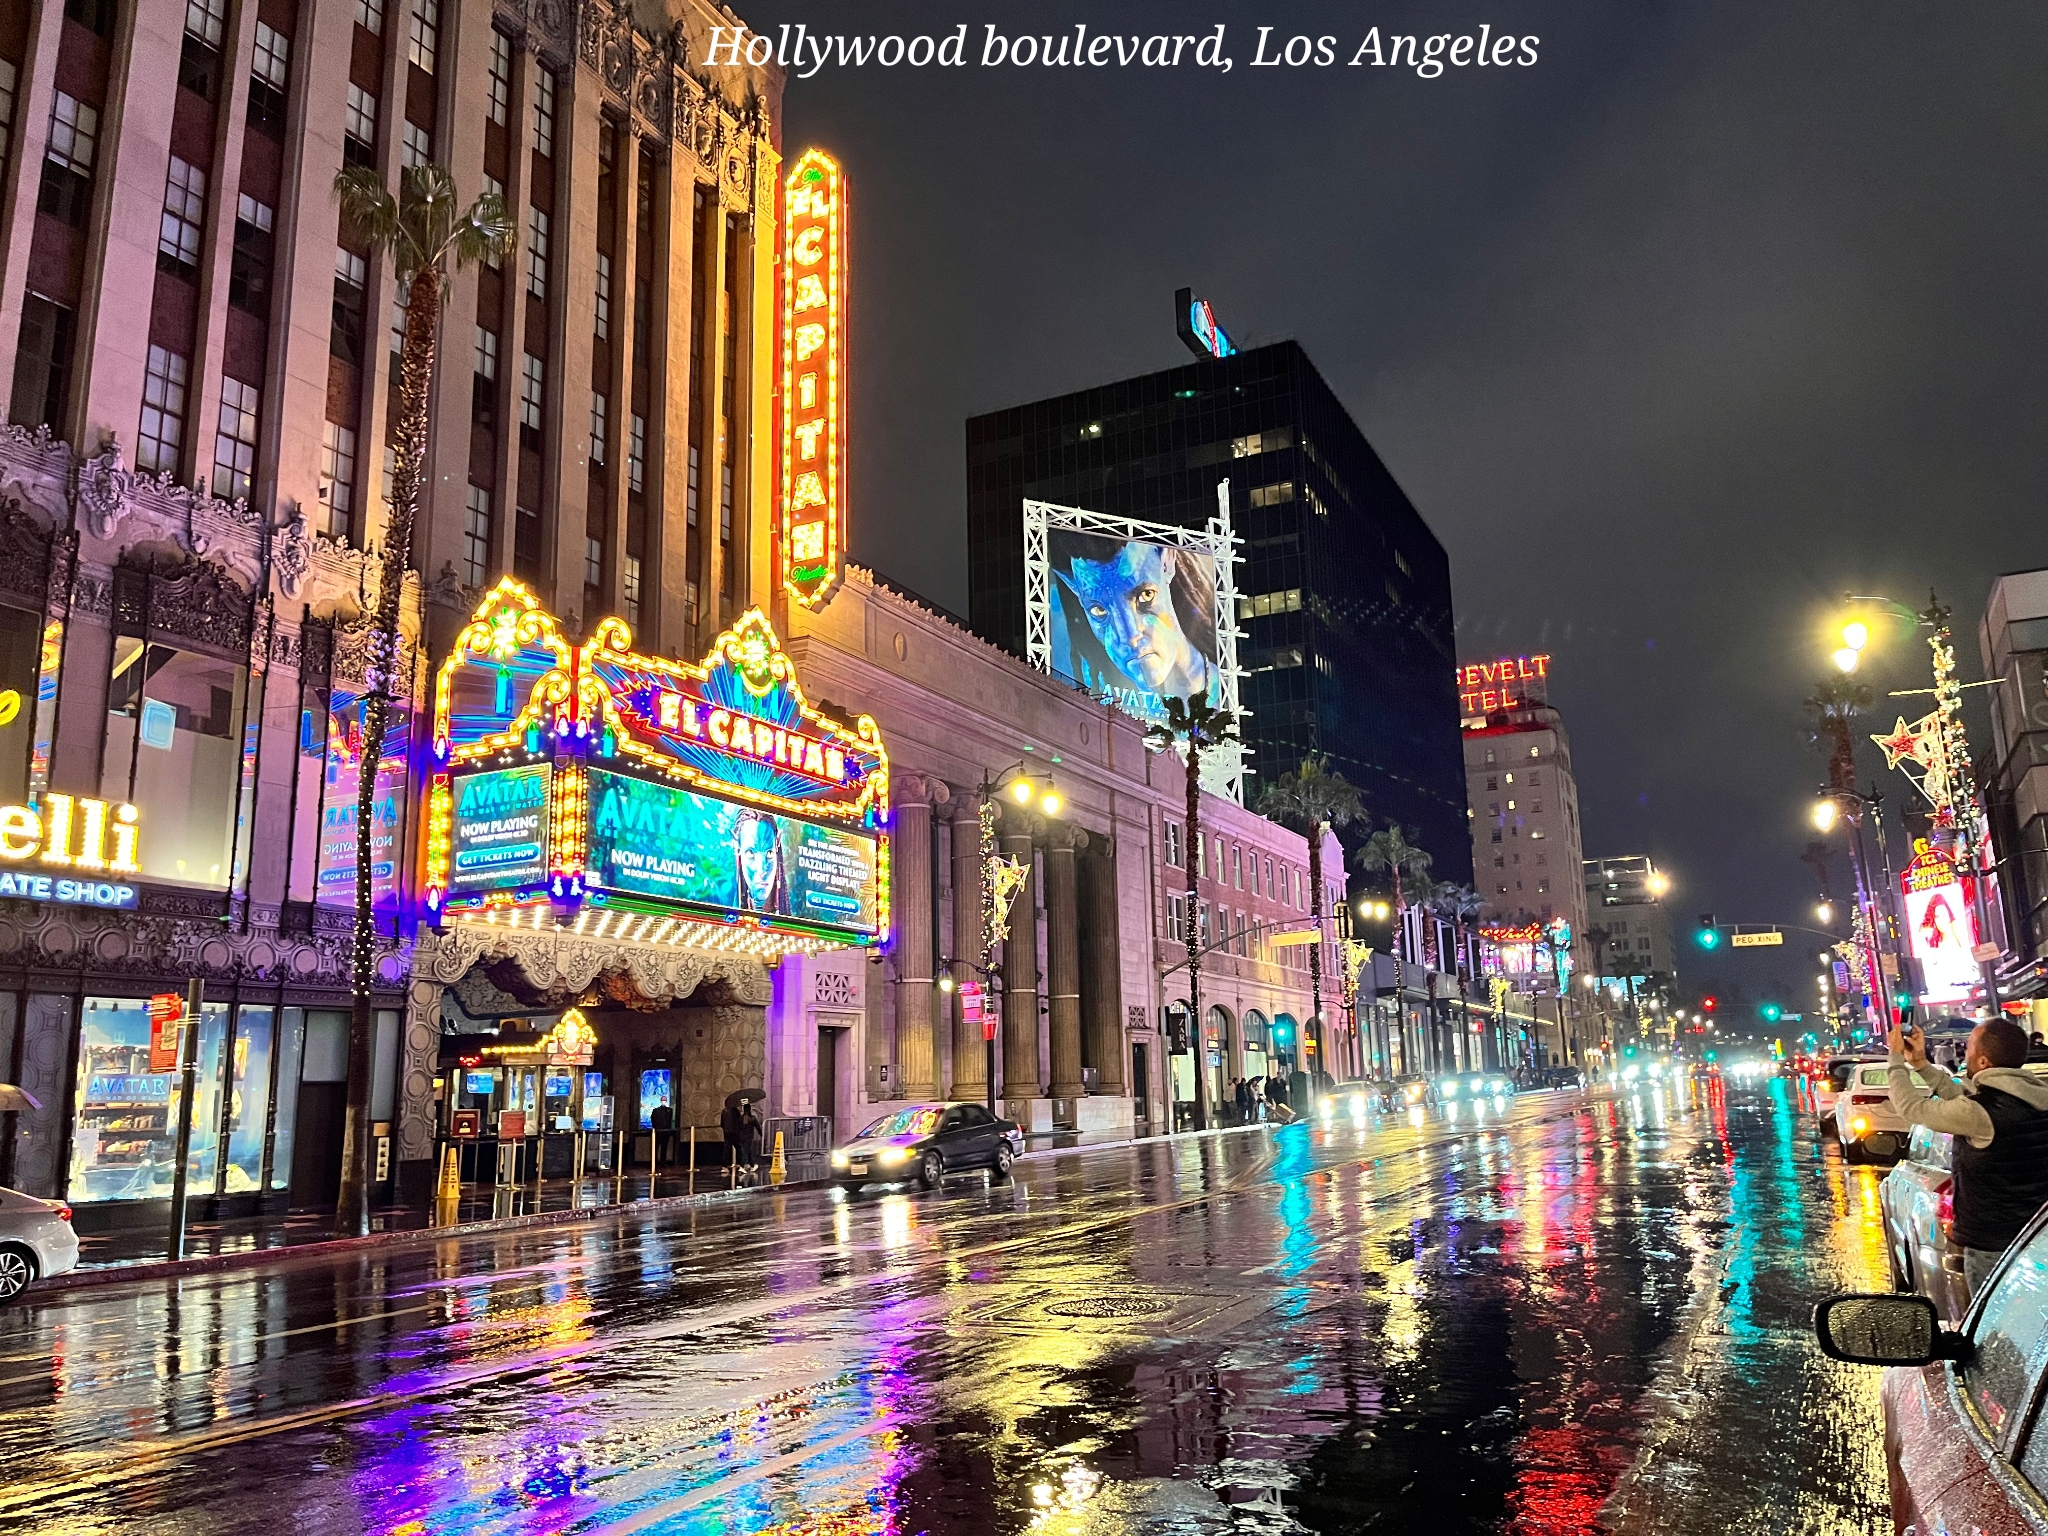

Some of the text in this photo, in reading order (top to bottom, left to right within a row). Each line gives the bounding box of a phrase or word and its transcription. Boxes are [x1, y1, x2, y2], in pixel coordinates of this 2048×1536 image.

[791, 184, 831, 220] EL
[790, 225, 830, 563] CAPITAN
[658, 691, 845, 781] EL CAPITAN
[459, 776, 543, 809] AVATAR
[0, 792, 143, 873] elli
[460, 814, 538, 837] NOW PLAYING
[461, 848, 534, 865] GET TICKETS NOW
[611, 849, 694, 877] NOW PLAYING
[798, 846, 850, 866] TRANSFORMED
[1920, 853, 1938, 867] TCL
[799, 858, 868, 881] DAZZLING THEMED
[808, 871, 860, 888] LIGHT DISPLAY!
[1910, 871, 1955, 891] THEATRES
[1911, 861, 1950, 878] CHINESE
[0, 872, 134, 906] ATE SHOP
[1735, 934, 1779, 944] PED XING
[1178, 1018, 1186, 1049] ZARA
[88, 1074, 167, 1097] AVATAR
